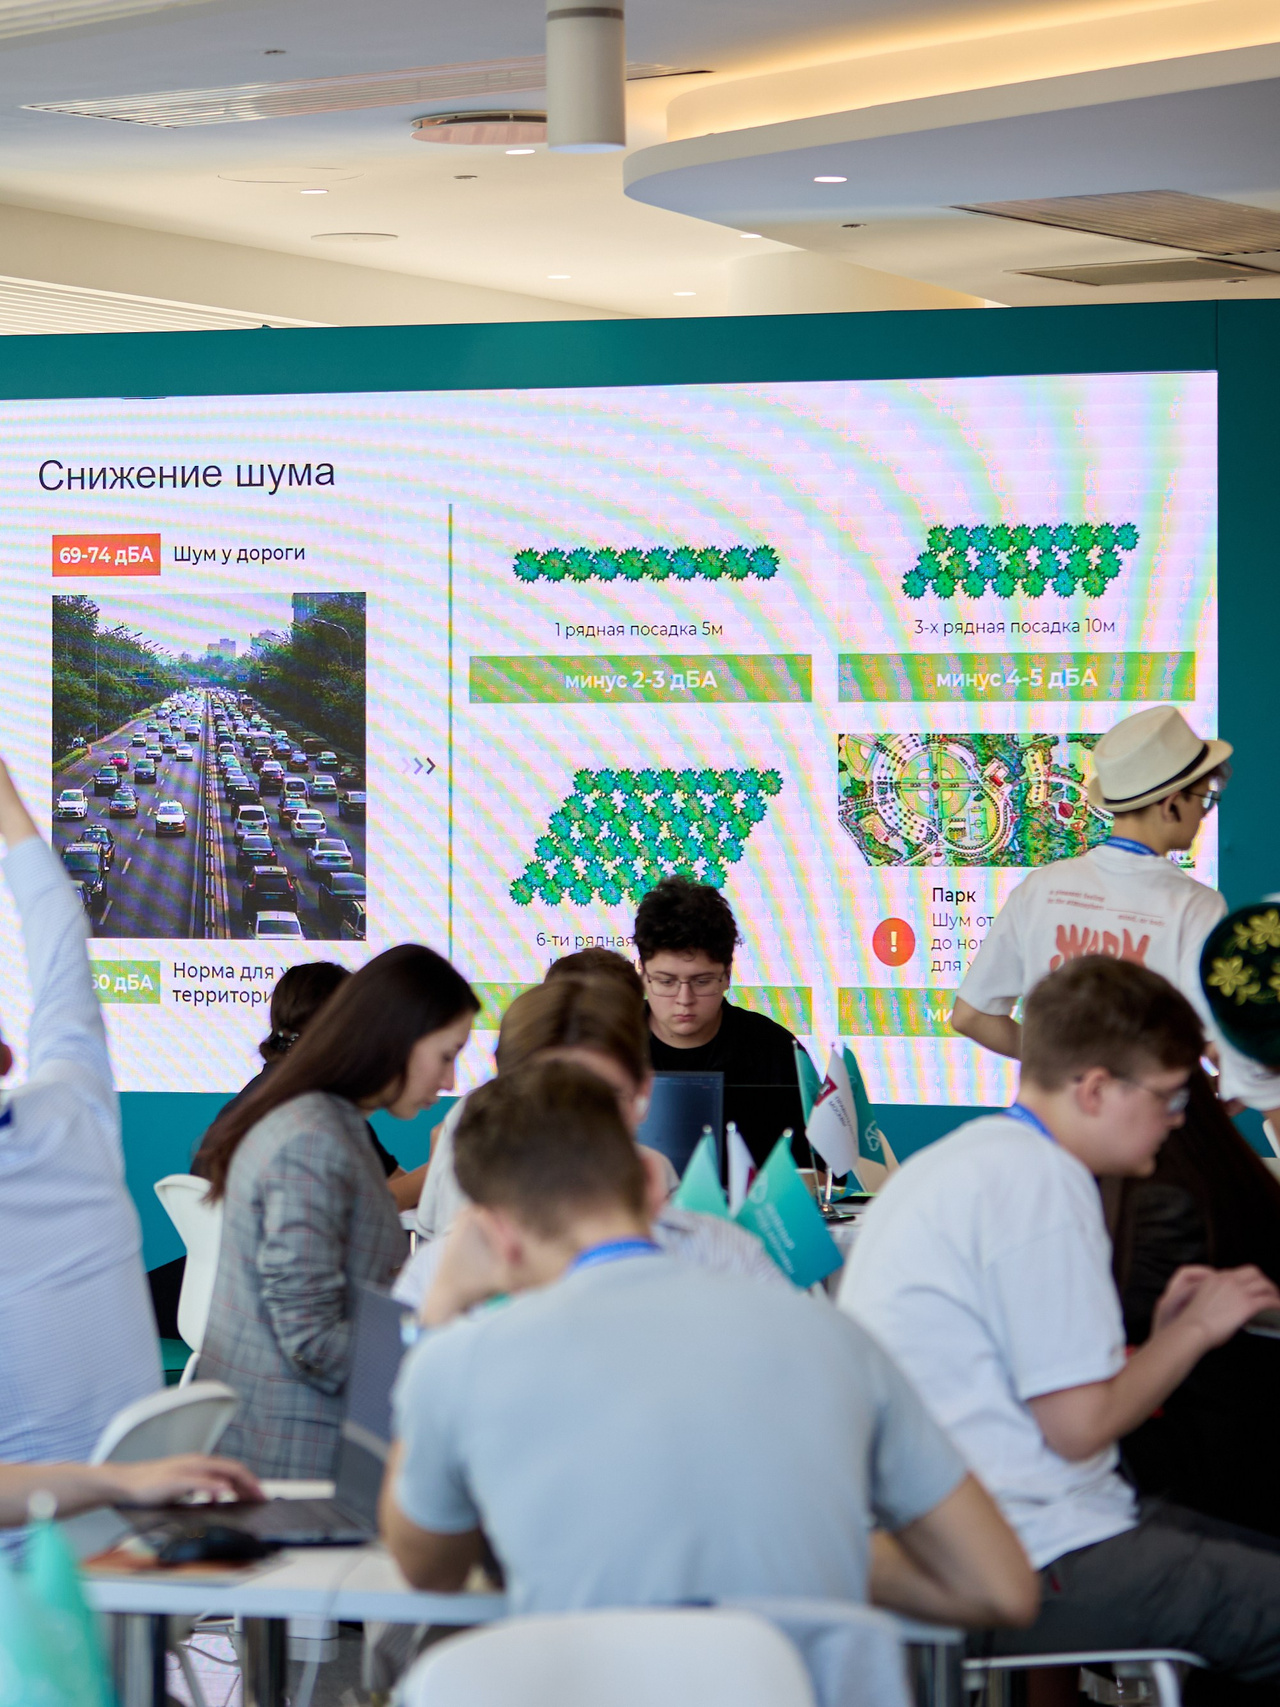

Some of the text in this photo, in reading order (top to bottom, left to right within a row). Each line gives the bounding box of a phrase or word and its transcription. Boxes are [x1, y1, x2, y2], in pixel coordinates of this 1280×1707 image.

[38, 460, 335, 495] Снижение шума
[59, 545, 154, 566] 69-74 дБА
[173, 546, 306, 565] Шум у дороги
[554, 621, 723, 640] 1 рядная посадка 5м
[914, 618, 1115, 637] 3-х рядная посадка 10м
[565, 670, 718, 693] минус 2-3 дБА
[936, 668, 1099, 691] минус 4-5 дБА
[932, 887, 976, 906] Парк
[932, 913, 971, 931] Шум
[536, 932, 634, 949] 6-ти рядная
[931, 938, 952, 951] до
[173, 962, 234, 982] Норма
[240, 966, 274, 982] для
[931, 960, 962, 973] для
[114, 974, 154, 993] дБА
